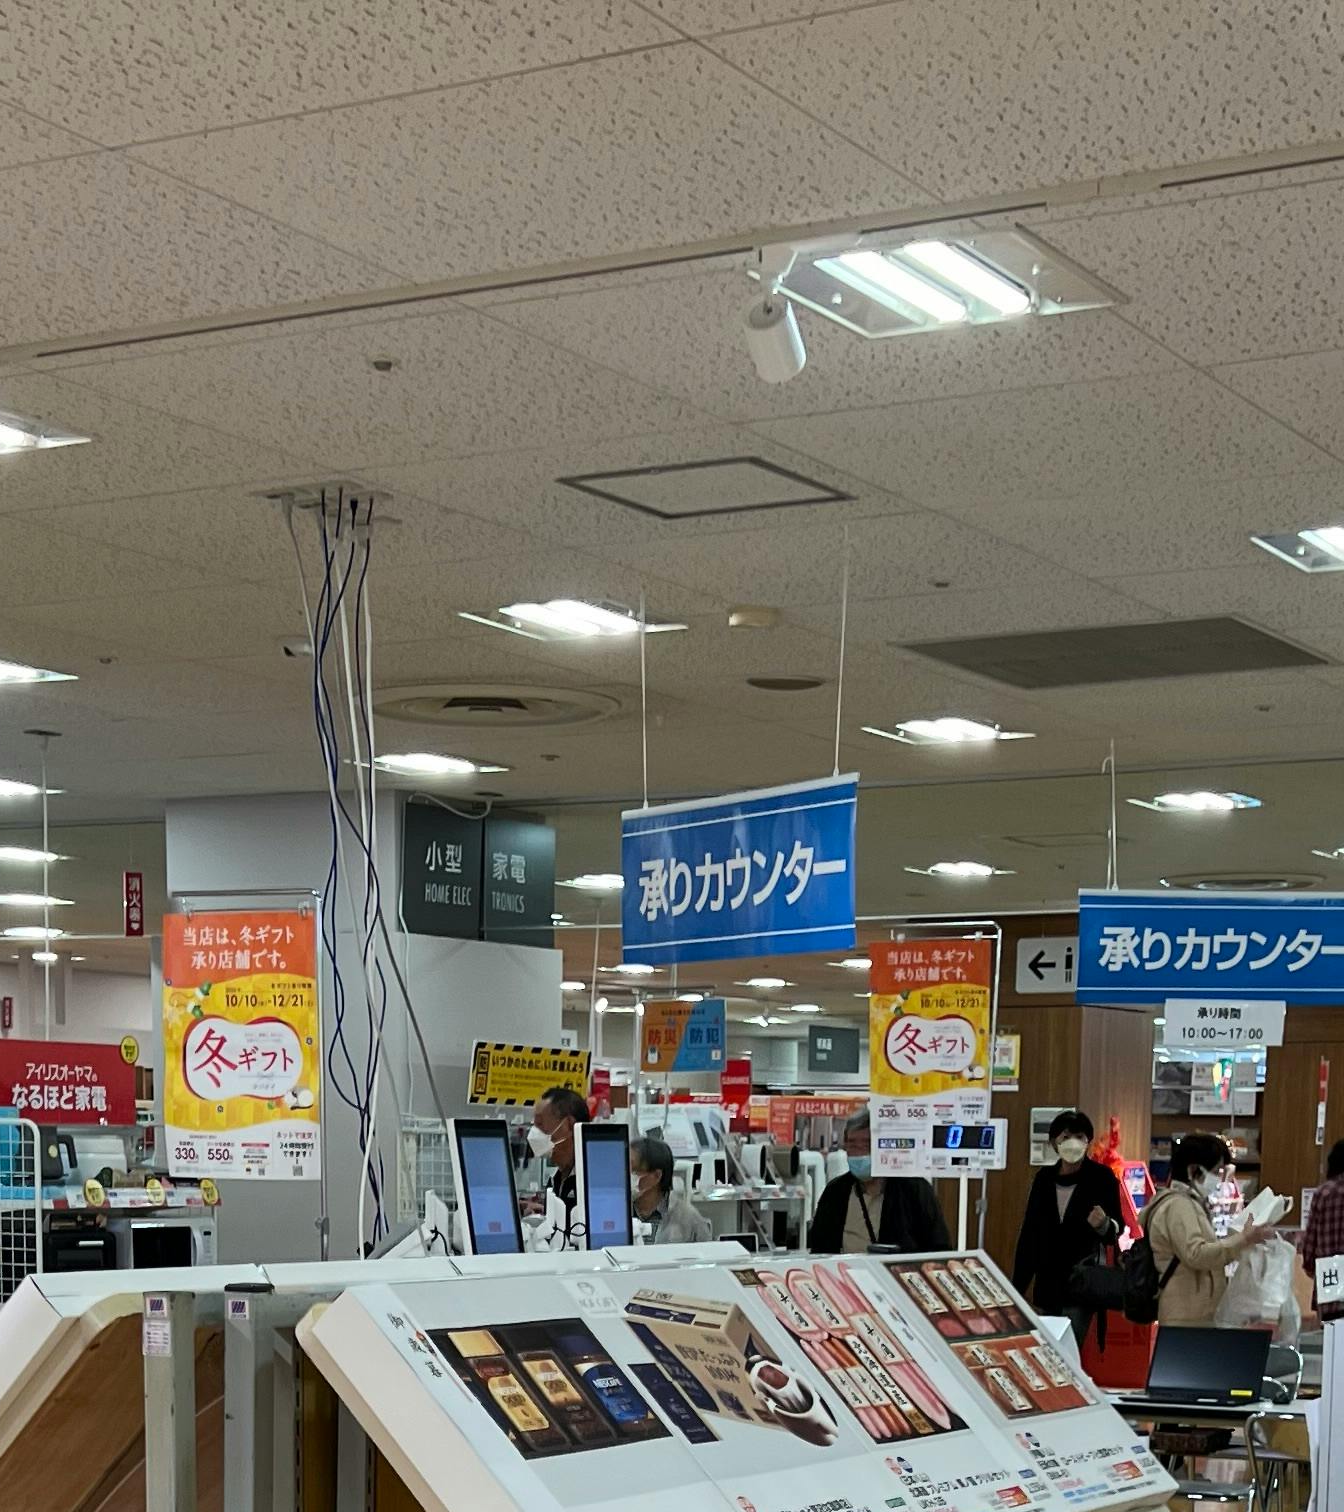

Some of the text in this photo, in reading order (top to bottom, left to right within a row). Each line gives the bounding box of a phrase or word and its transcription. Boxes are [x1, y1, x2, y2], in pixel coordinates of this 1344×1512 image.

[425, 841, 527, 884] 小型 家電
[639, 838, 847, 923] 承りカウンター
[425, 883, 452, 904] HOME
[183, 925, 295, 946] 当店は、冬ギフト
[191, 950, 288, 970] 承り店舗です。
[12, 1085, 107, 1111] なるほど家電
